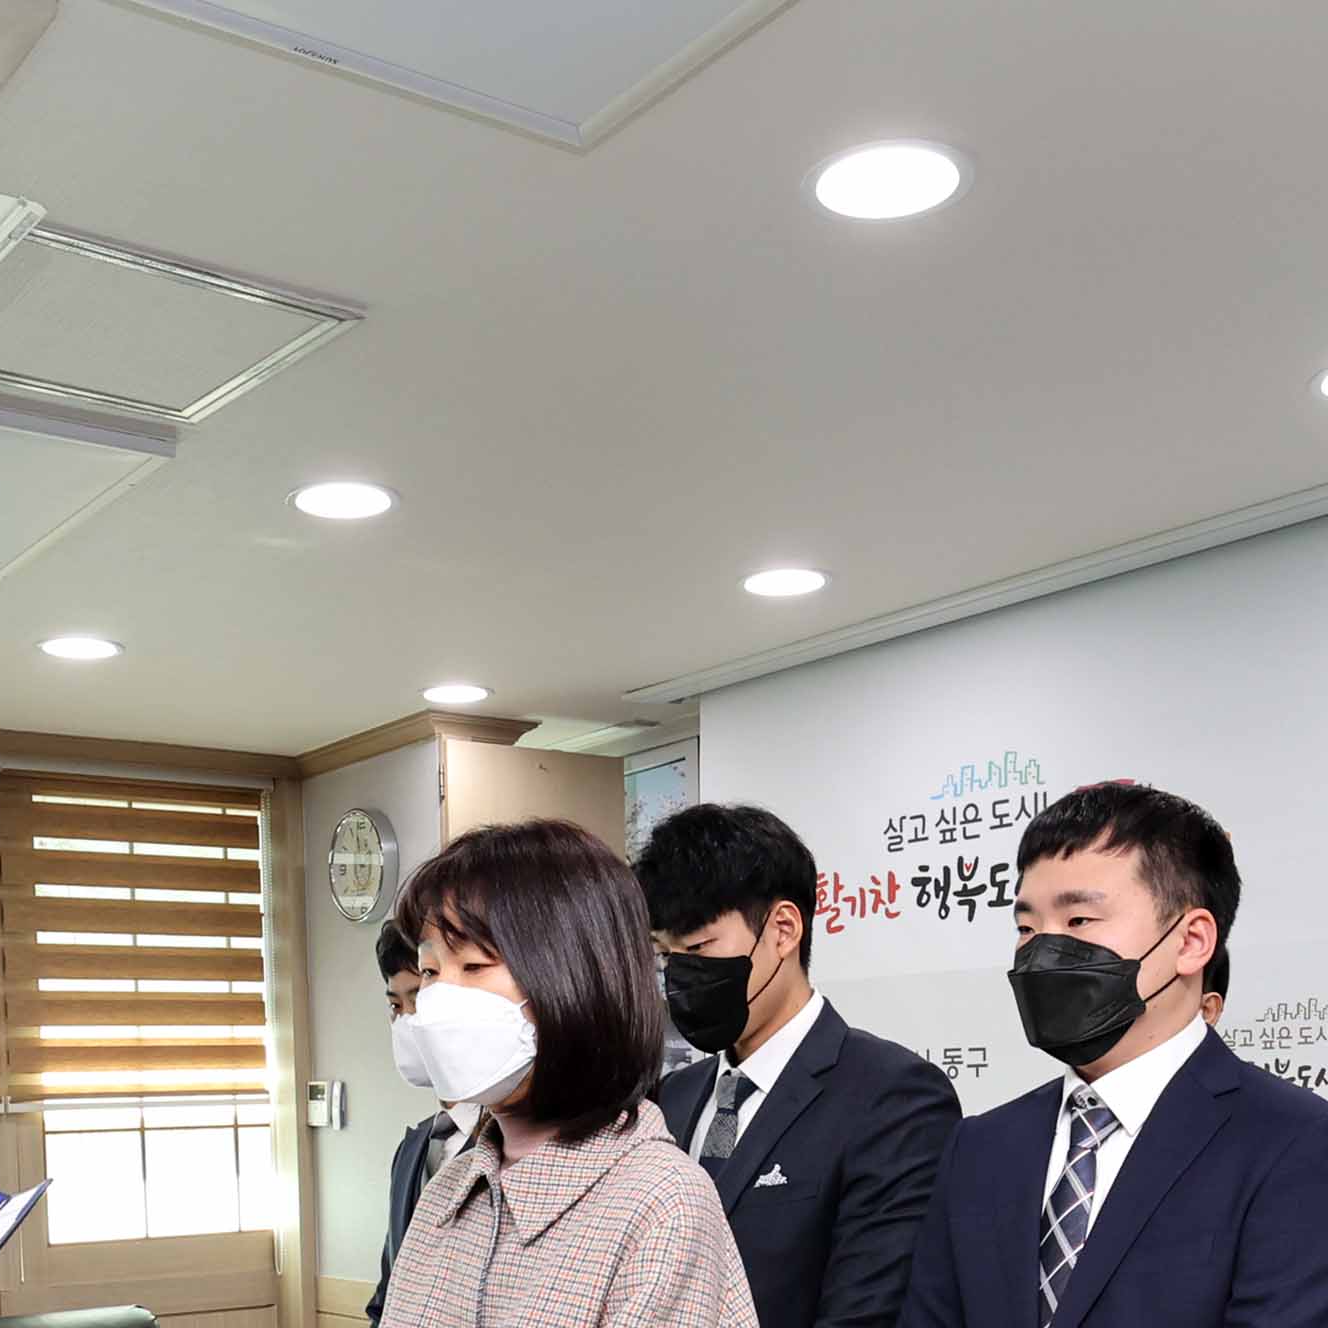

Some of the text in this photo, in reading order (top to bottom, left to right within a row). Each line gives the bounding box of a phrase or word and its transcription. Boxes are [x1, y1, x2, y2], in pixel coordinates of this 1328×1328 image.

[883, 813, 929, 853] 살고
[935, 803, 983, 844] 싶은
[911, 856, 1024, 922] 행복도
[1260, 1027, 1293, 1050] 싶은
[942, 1047, 988, 1079] 동구
